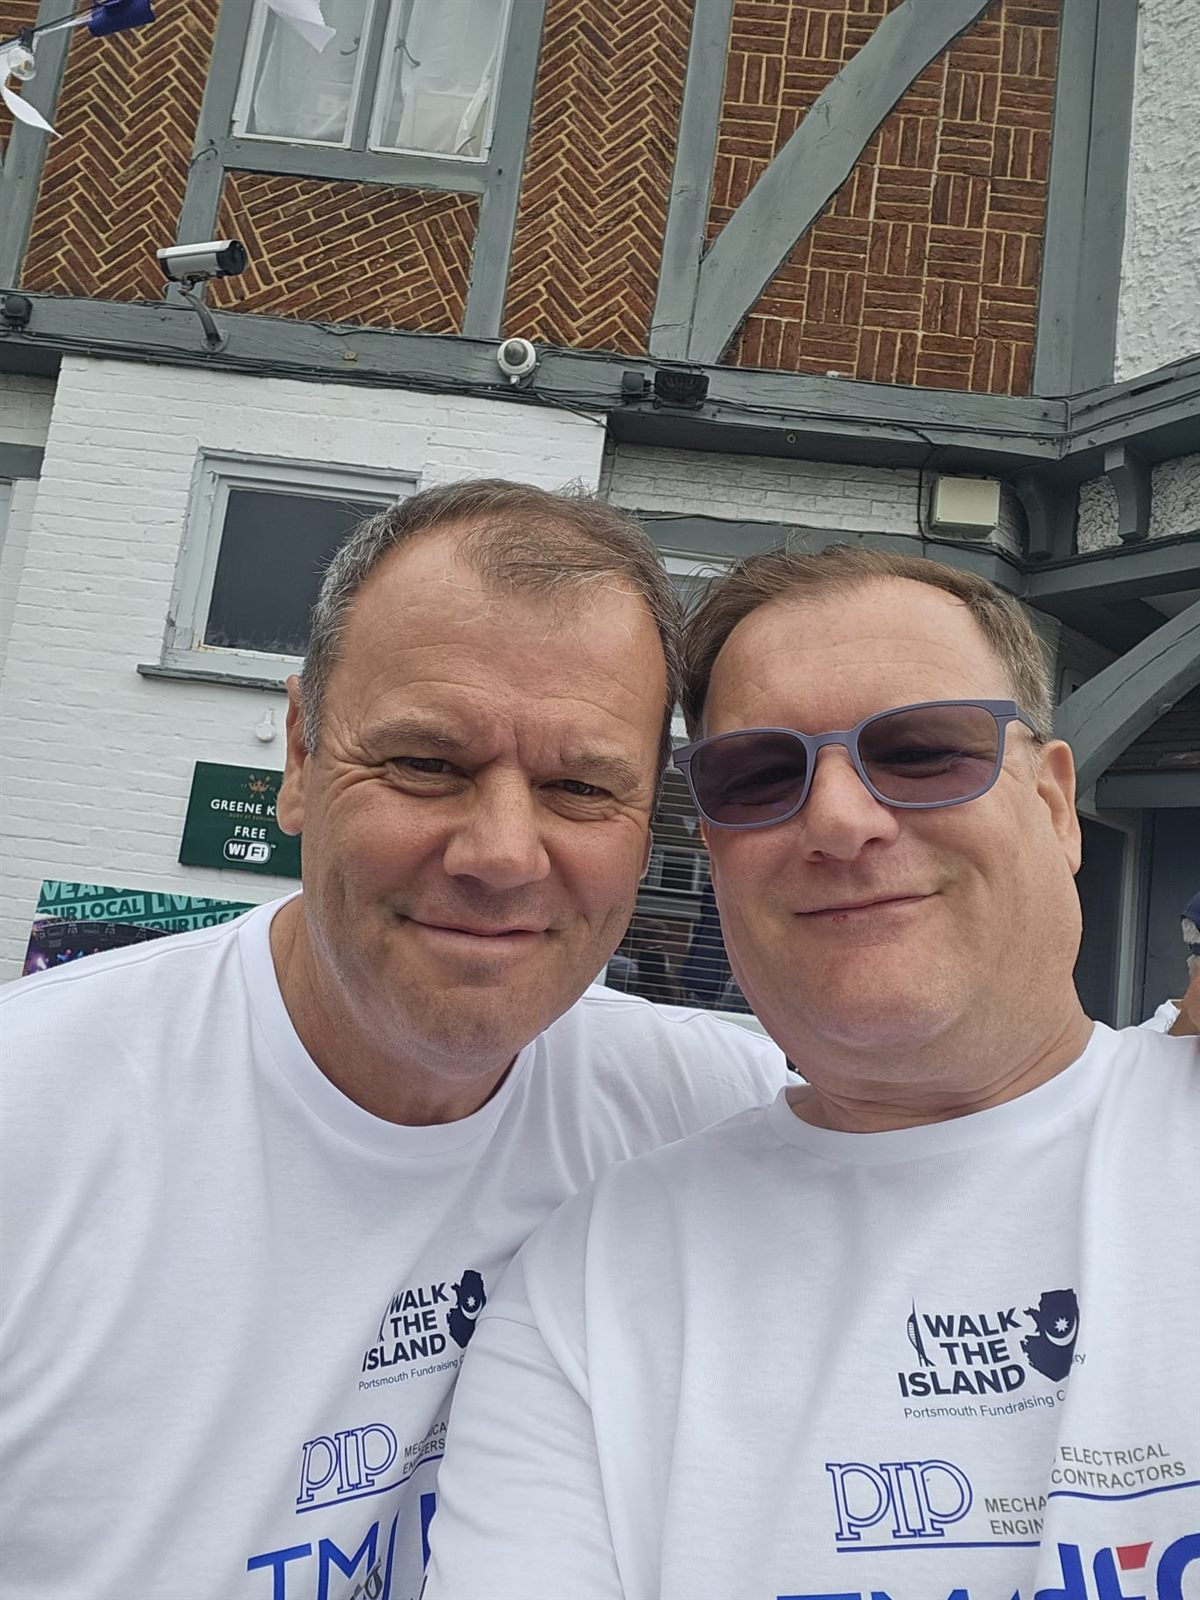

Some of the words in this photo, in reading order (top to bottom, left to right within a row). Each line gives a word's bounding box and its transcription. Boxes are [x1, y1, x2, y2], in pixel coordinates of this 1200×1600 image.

[210, 799, 263, 815] GREENE
[234, 826, 267, 839] FREE
[79, 897, 142, 920] LOCAL
[151, 894, 206, 914] LIVE
[390, 1282, 450, 1315] WALK
[390, 1309, 438, 1338] THE
[923, 1307, 1022, 1338] WALK
[362, 1333, 447, 1373] ISLAND
[940, 1339, 1011, 1365] THE
[359, 1373, 409, 1391] Portsmouth
[410, 1359, 459, 1378] Fundraising
[898, 1364, 1026, 1397] ISLAND
[904, 1407, 978, 1419] Portsmouth
[980, 1395, 1055, 1417] Fundraising
[985, 1495, 1047, 1513] MECHA
[1060, 1443, 1170, 1466] ELECTRICAL
[1051, 1461, 1186, 1489] CONTRACTORS
